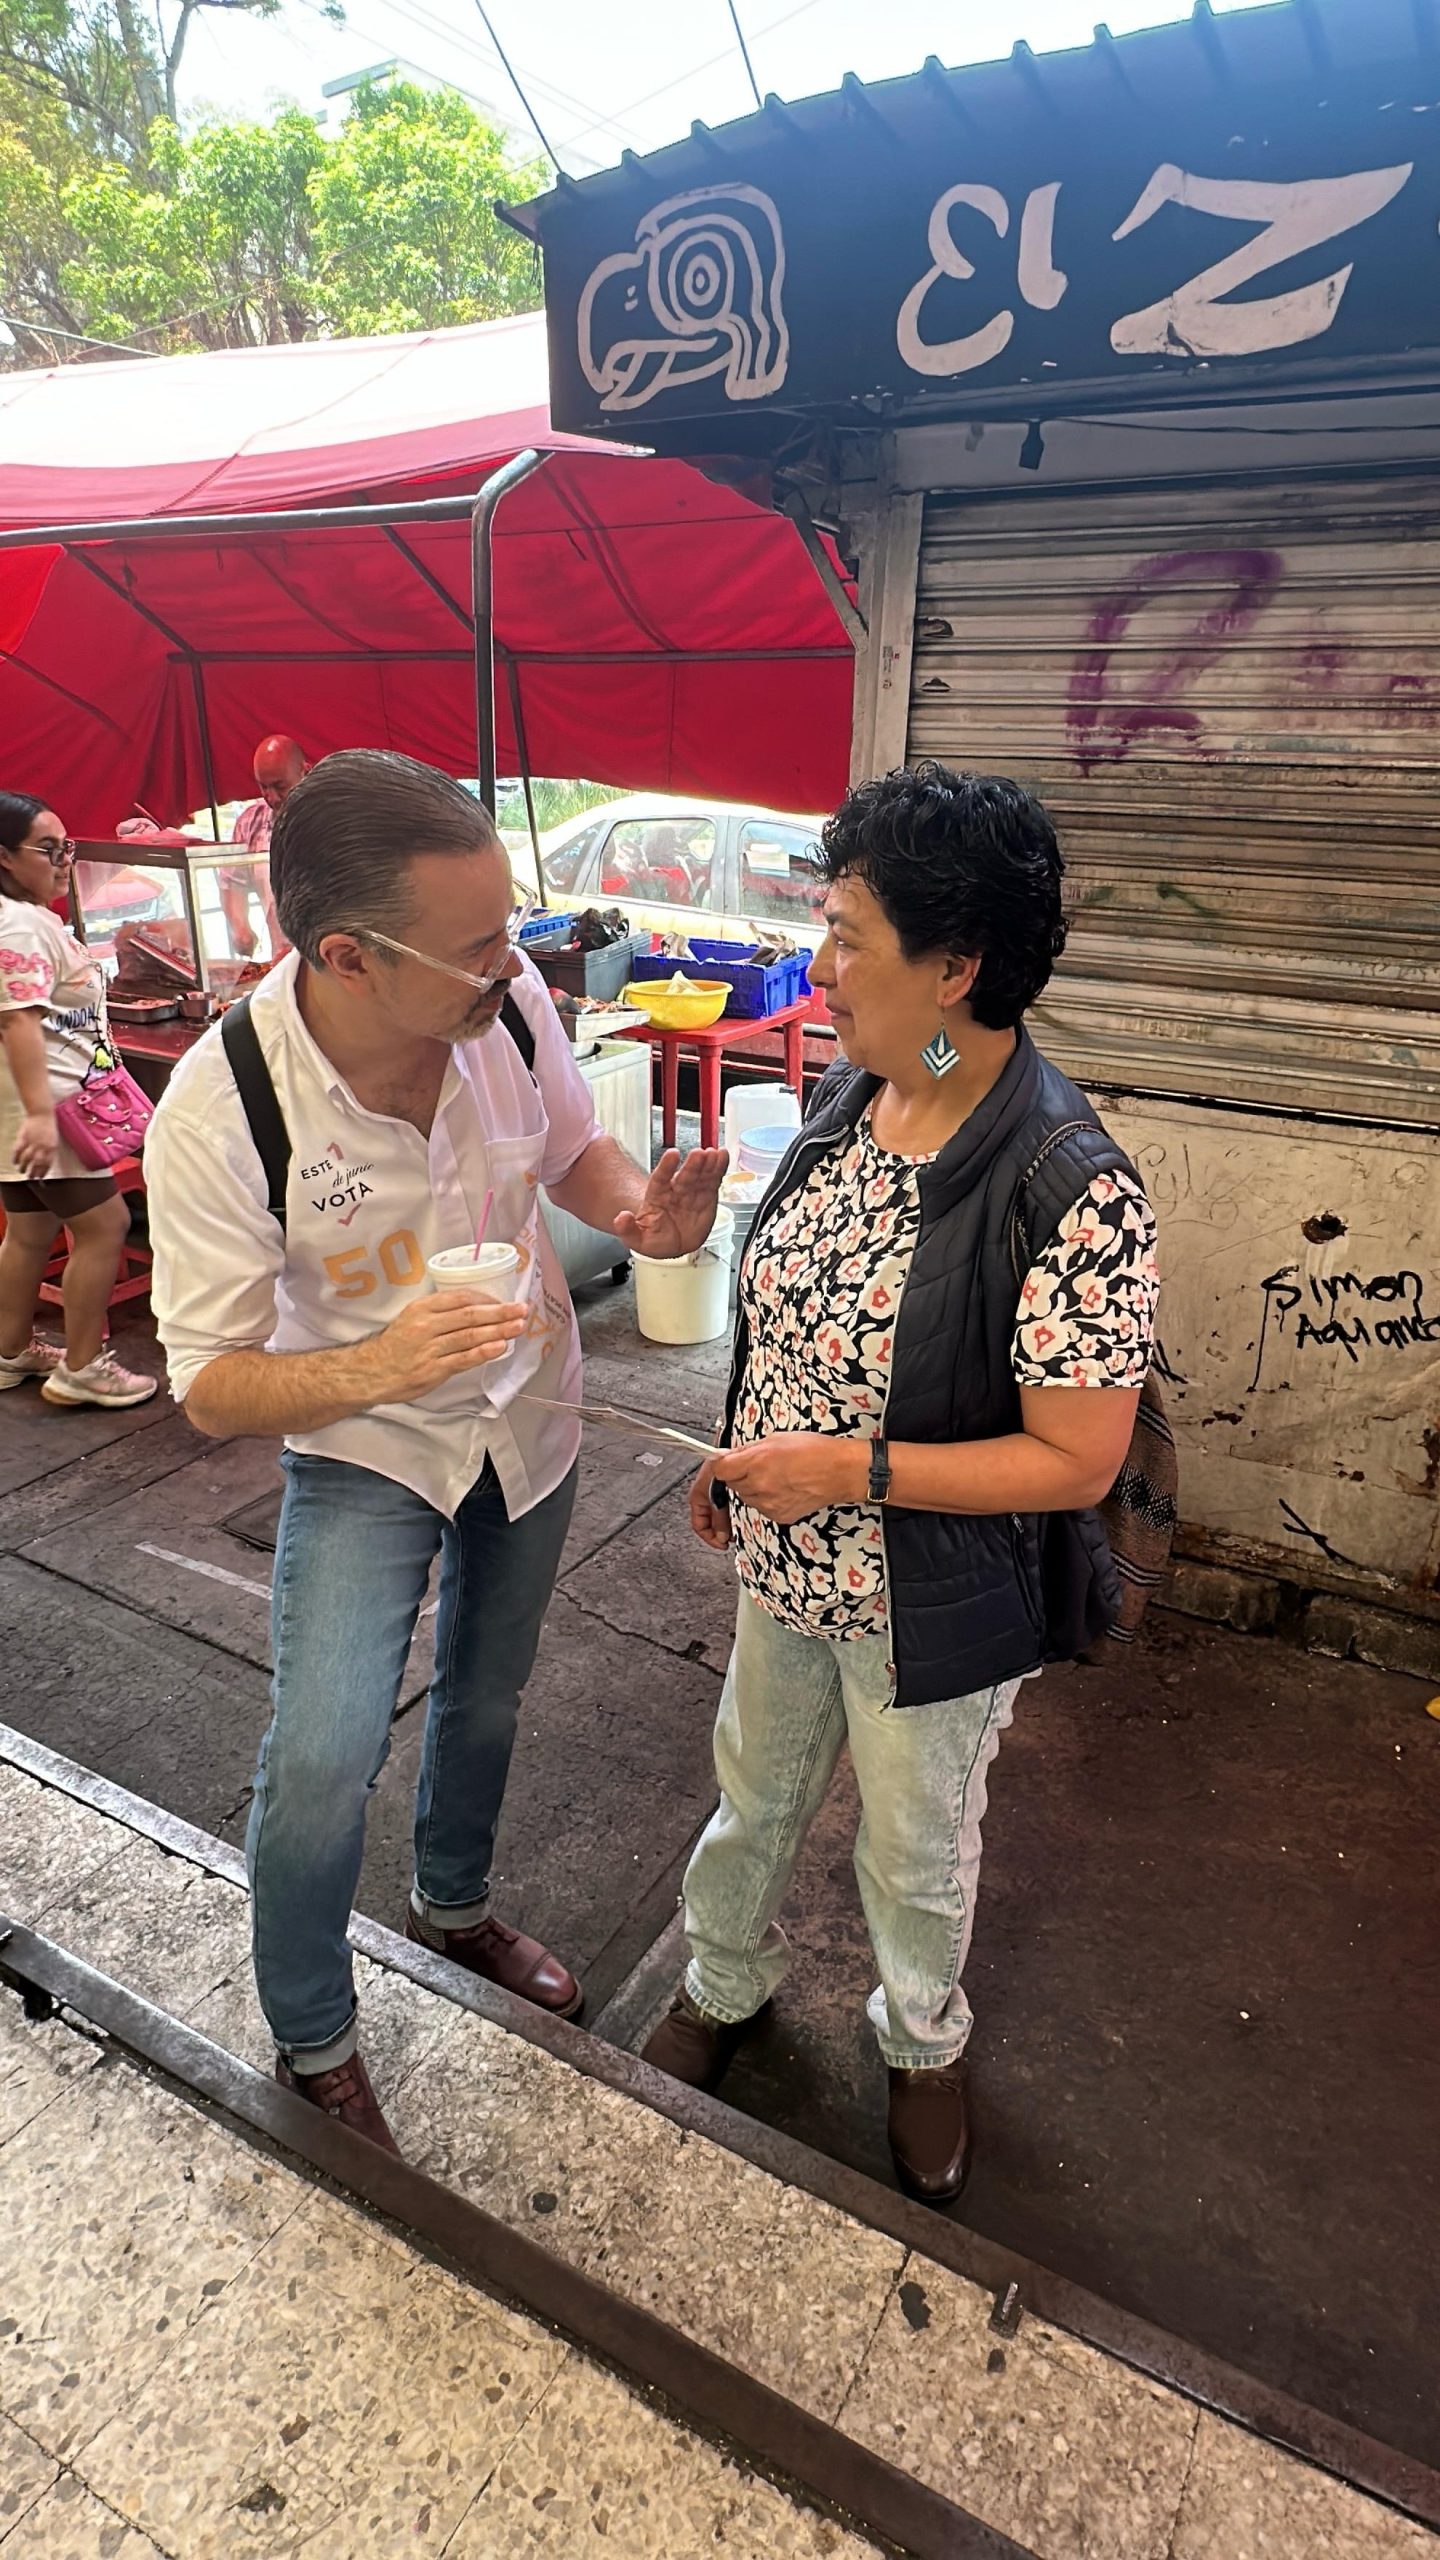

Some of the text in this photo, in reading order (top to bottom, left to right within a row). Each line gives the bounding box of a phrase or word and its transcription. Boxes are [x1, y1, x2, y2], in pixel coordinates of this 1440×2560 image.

[897, 161, 1440, 376] El Z
[301, 1159, 333, 1180] ESTE
[332, 1170, 345, 1188] de
[311, 1181, 374, 1212] VOTA
[322, 1228, 426, 1298] 50
